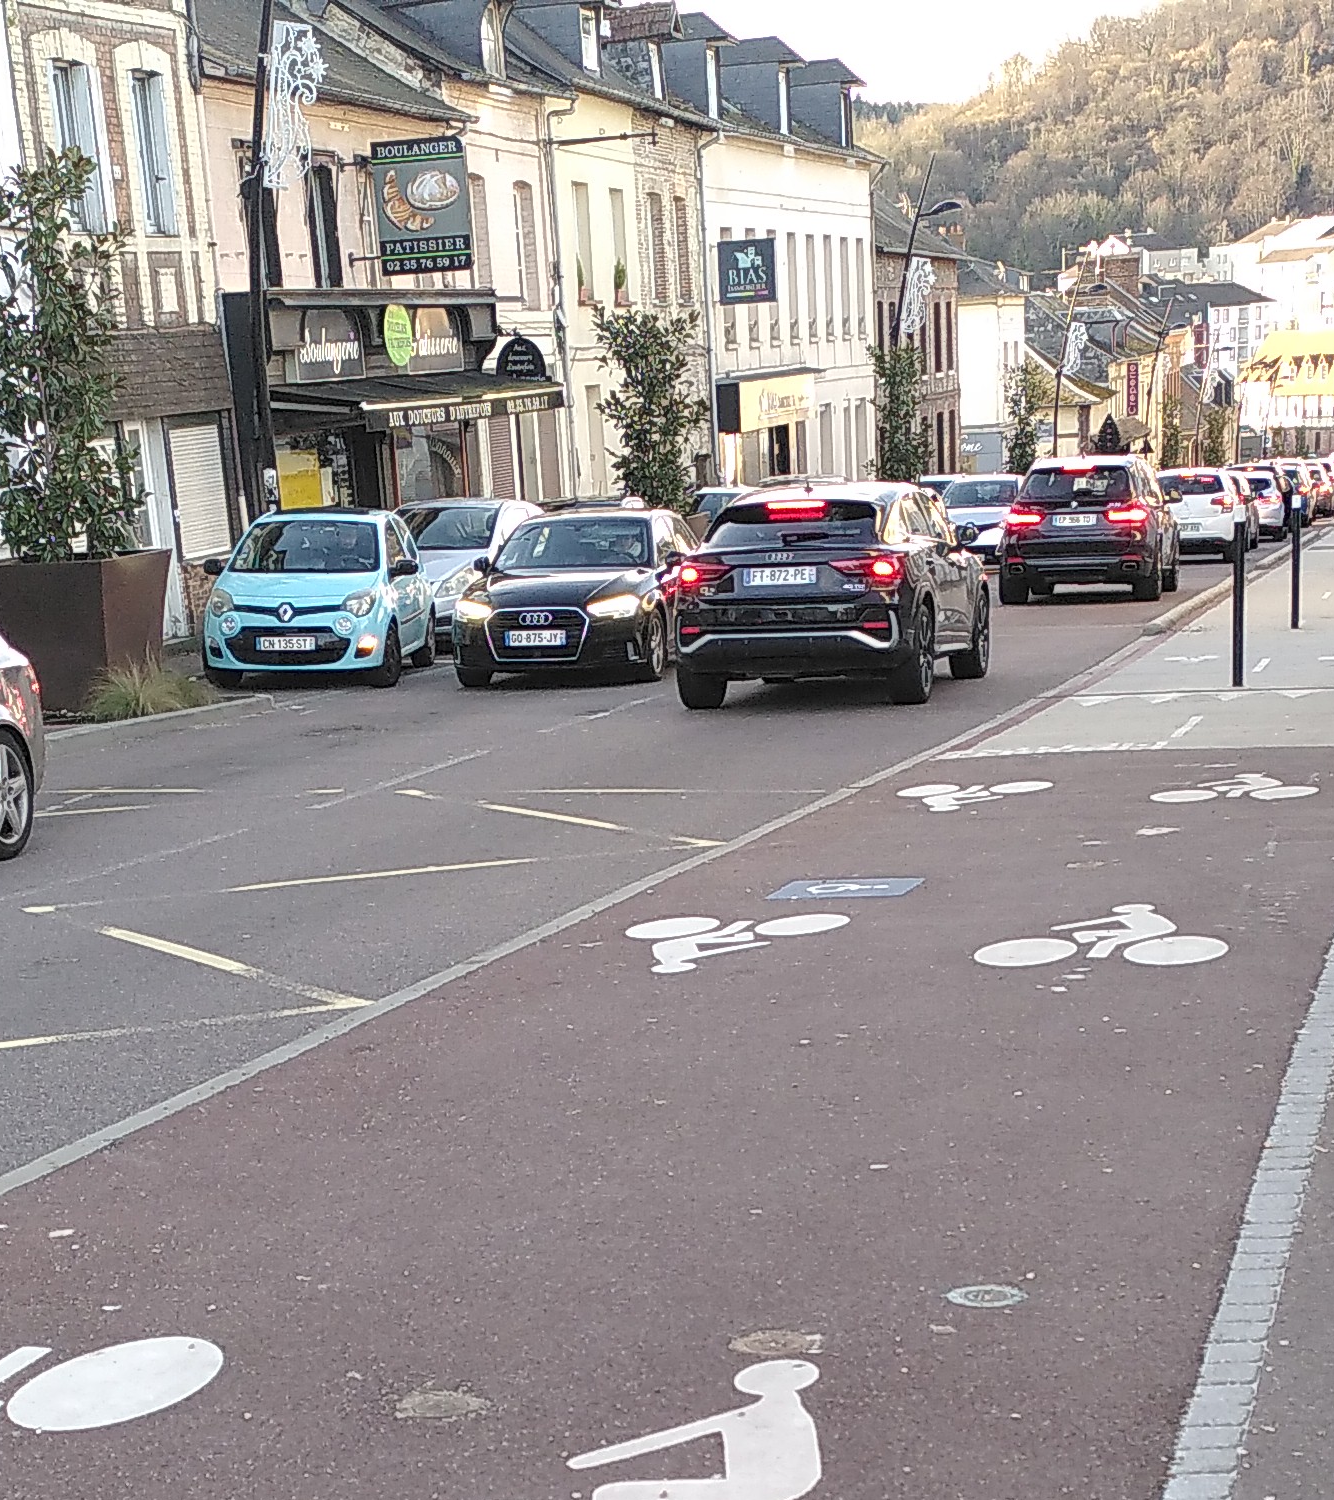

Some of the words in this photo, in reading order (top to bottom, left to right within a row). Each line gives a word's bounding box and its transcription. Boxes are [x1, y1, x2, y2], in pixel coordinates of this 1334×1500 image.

[376, 140, 457, 158] BOULANGER
[385, 237, 466, 255] PATISSIER
[386, 260, 401, 272] 02
[403, 259, 418, 271] 35
[420, 257, 434, 269] 76
[436, 256, 450, 268] 59
[453, 255, 467, 267] 17
[728, 266, 767, 285] BIAS
[299, 327, 360, 375] Boulangerie
[388, 410, 406, 427] AUX
[408, 406, 446, 425] DOUCEURS
